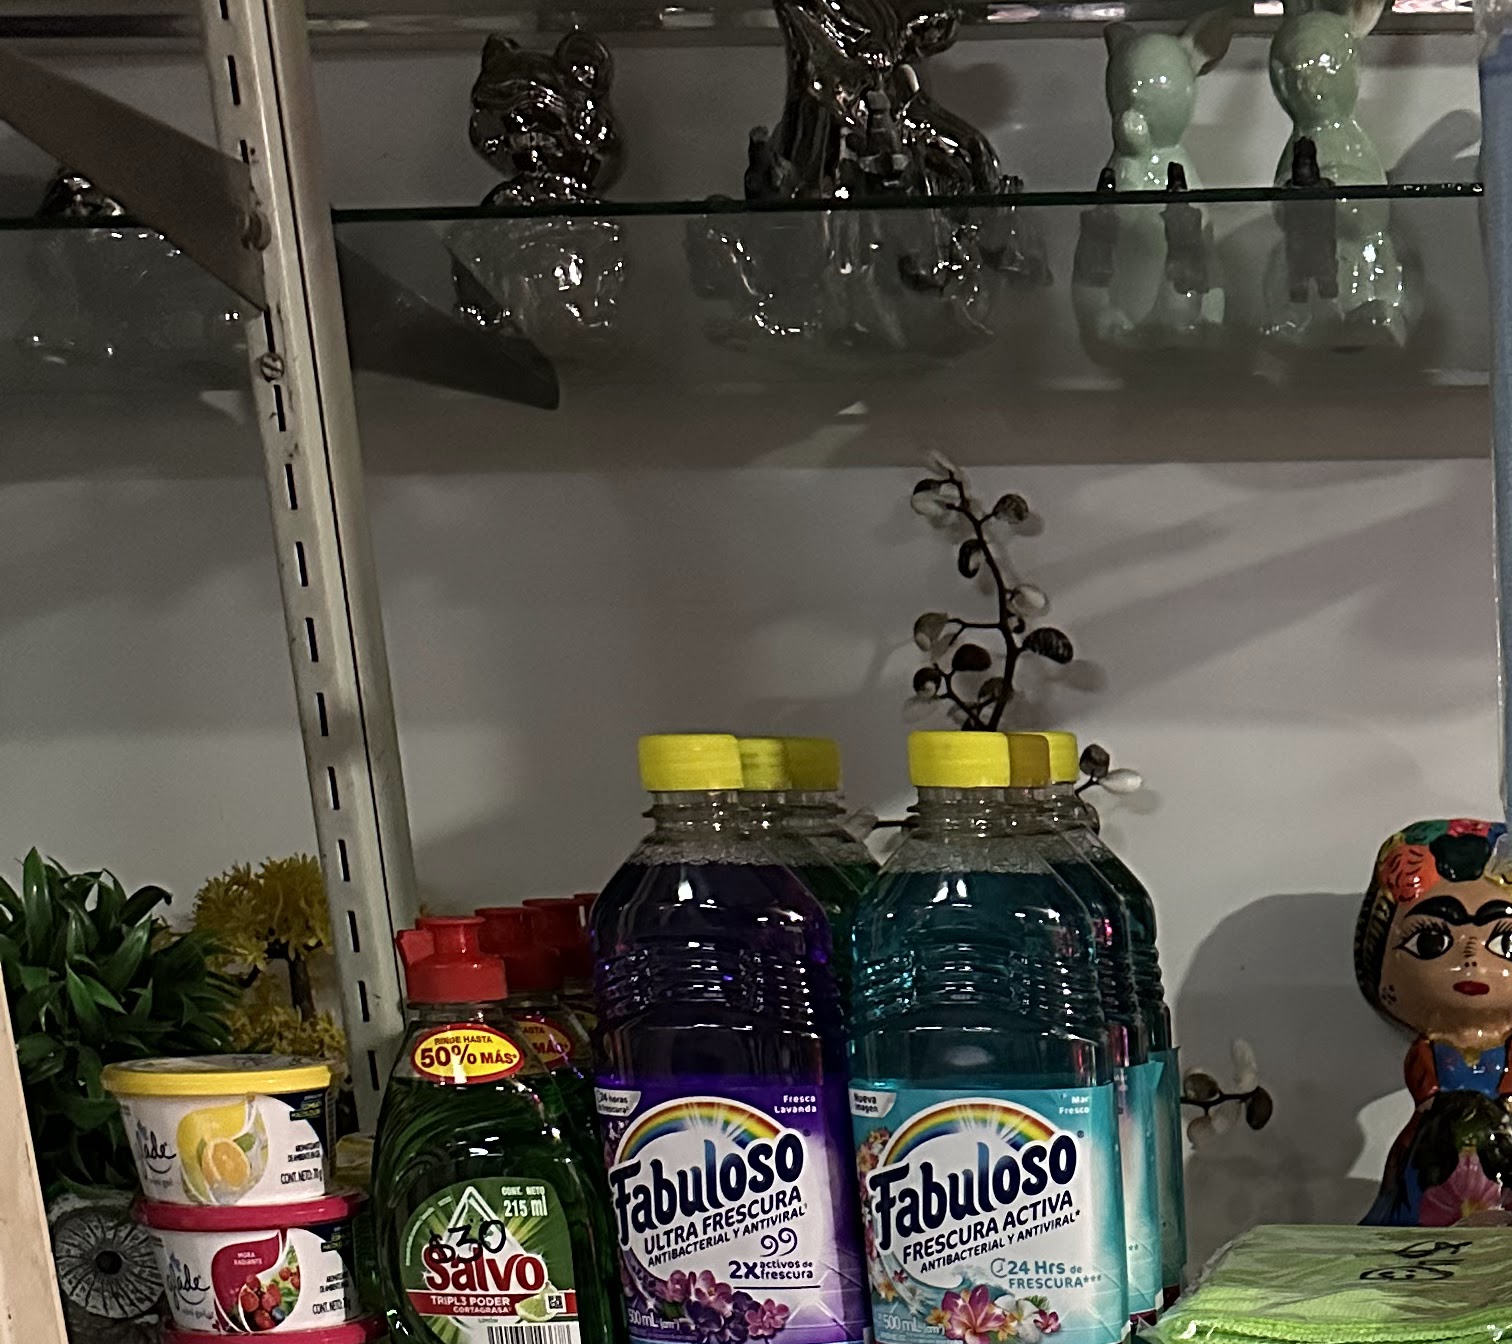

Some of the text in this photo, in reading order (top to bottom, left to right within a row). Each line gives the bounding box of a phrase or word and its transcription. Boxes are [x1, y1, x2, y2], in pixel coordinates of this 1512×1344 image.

[463, 1034, 493, 1045] HASTA
[420, 1043, 477, 1069] 50%
[773, 1104, 817, 1114] Lavanda
[783, 1094, 816, 1104] Fresca
[1059, 1106, 1090, 1115] Fresco
[525, 1186, 545, 1197] NETO
[609, 1132, 805, 1247] Fabuloso
[869, 1134, 1077, 1251] Fabuloso
[503, 1195, 548, 1219] 215 ml
[643, 1184, 802, 1256] ULTRA FRESCURA
[902, 1189, 1074, 1266] FRESCURA ACTIVA
[647, 1228, 741, 1268] ANTIBACTERIAL Y
[920, 1238, 1006, 1274] ANTIBACTERIAL
[728, 1260, 760, 1280] 2X
[760, 1259, 800, 1270] activos
[760, 1268, 814, 1280] frescura
[1008, 1259, 1082, 1275] 24 Hrs de
[429, 1296, 511, 1307] TRIPL3 PODER
